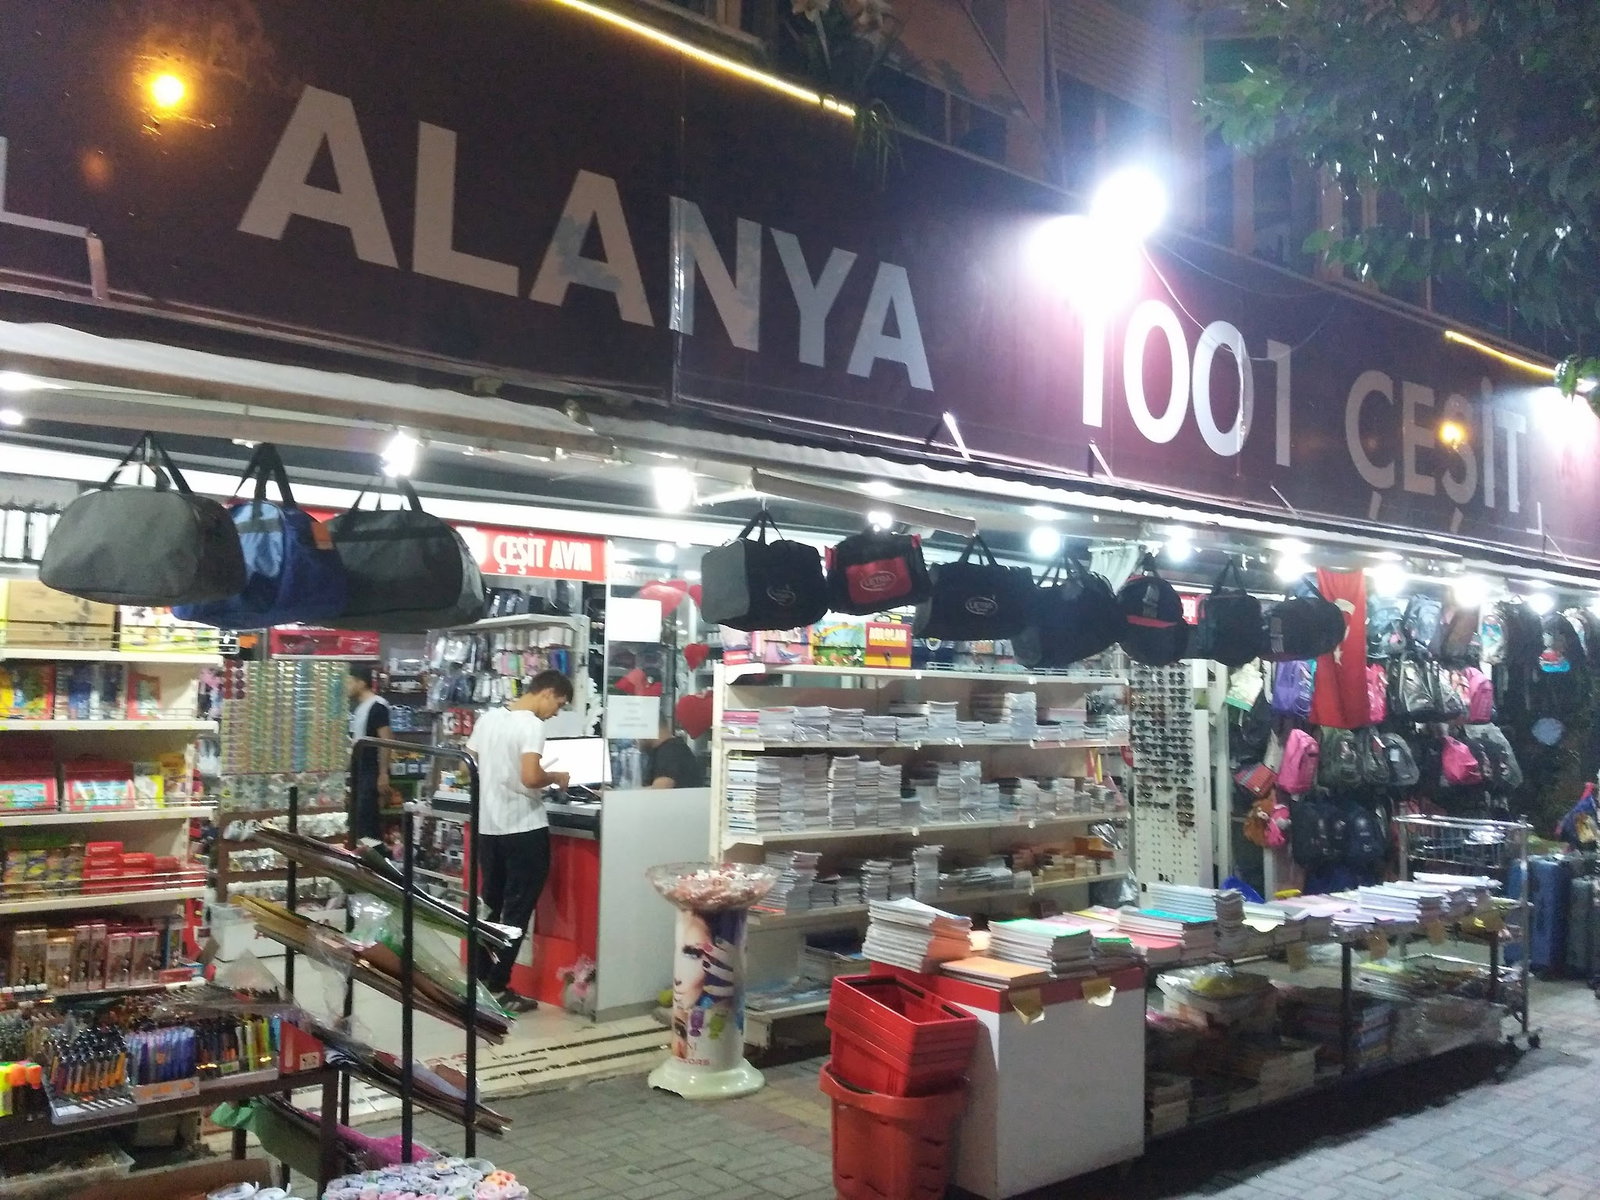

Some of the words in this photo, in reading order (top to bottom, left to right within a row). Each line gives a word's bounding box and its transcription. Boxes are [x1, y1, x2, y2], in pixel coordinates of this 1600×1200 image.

[238, 85, 935, 393] ALANYA
[1079, 288, 1292, 467] 1001
[1345, 369, 1527, 535] ÇEŞİT
[492, 533, 546, 575] ÇEŞİT
